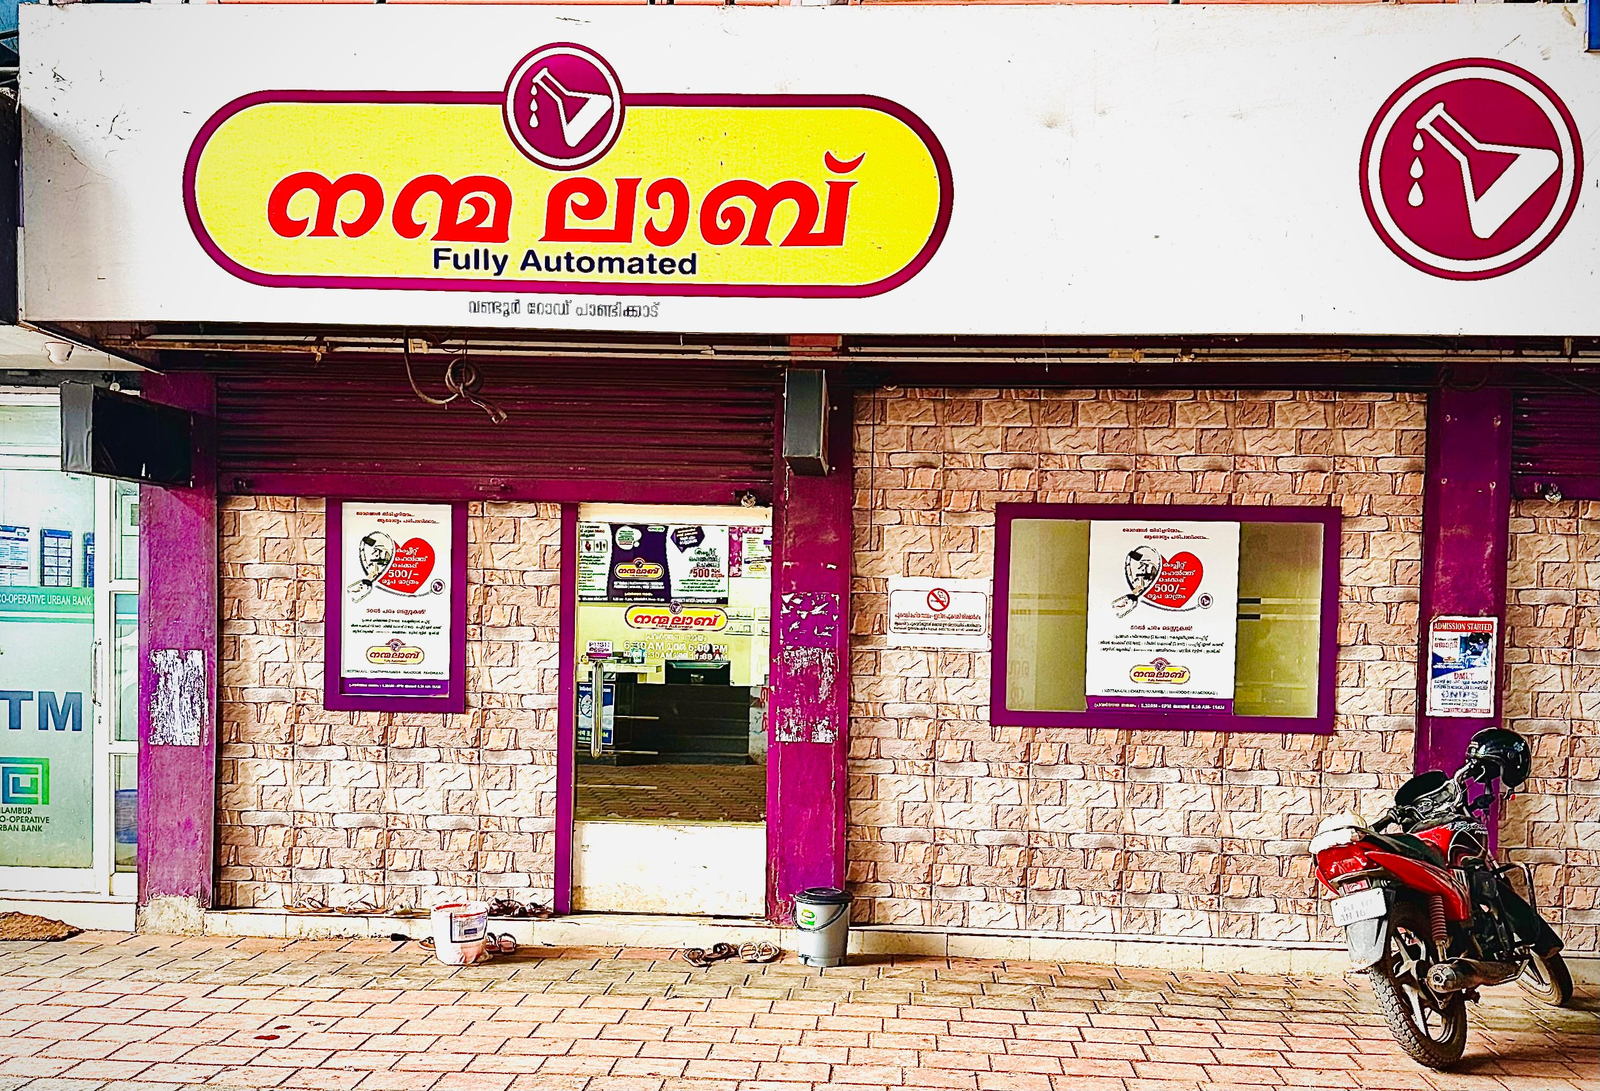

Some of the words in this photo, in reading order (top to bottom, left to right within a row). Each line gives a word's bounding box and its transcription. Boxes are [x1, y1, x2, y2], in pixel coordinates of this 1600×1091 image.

[433, 247, 508, 276] Fully
[520, 249, 697, 275] Automated
[527, 299, 572, 316] റോഡ്
[388, 569, 419, 579] 500/-
[1154, 583, 1186, 594] 500/-
[48, 595, 71, 605] URBAN
[72, 596, 92, 606] BANK
[1434, 622, 1466, 630] ADMISSION
[1467, 623, 1492, 631] STARTED
[712, 644, 728, 653] PM
